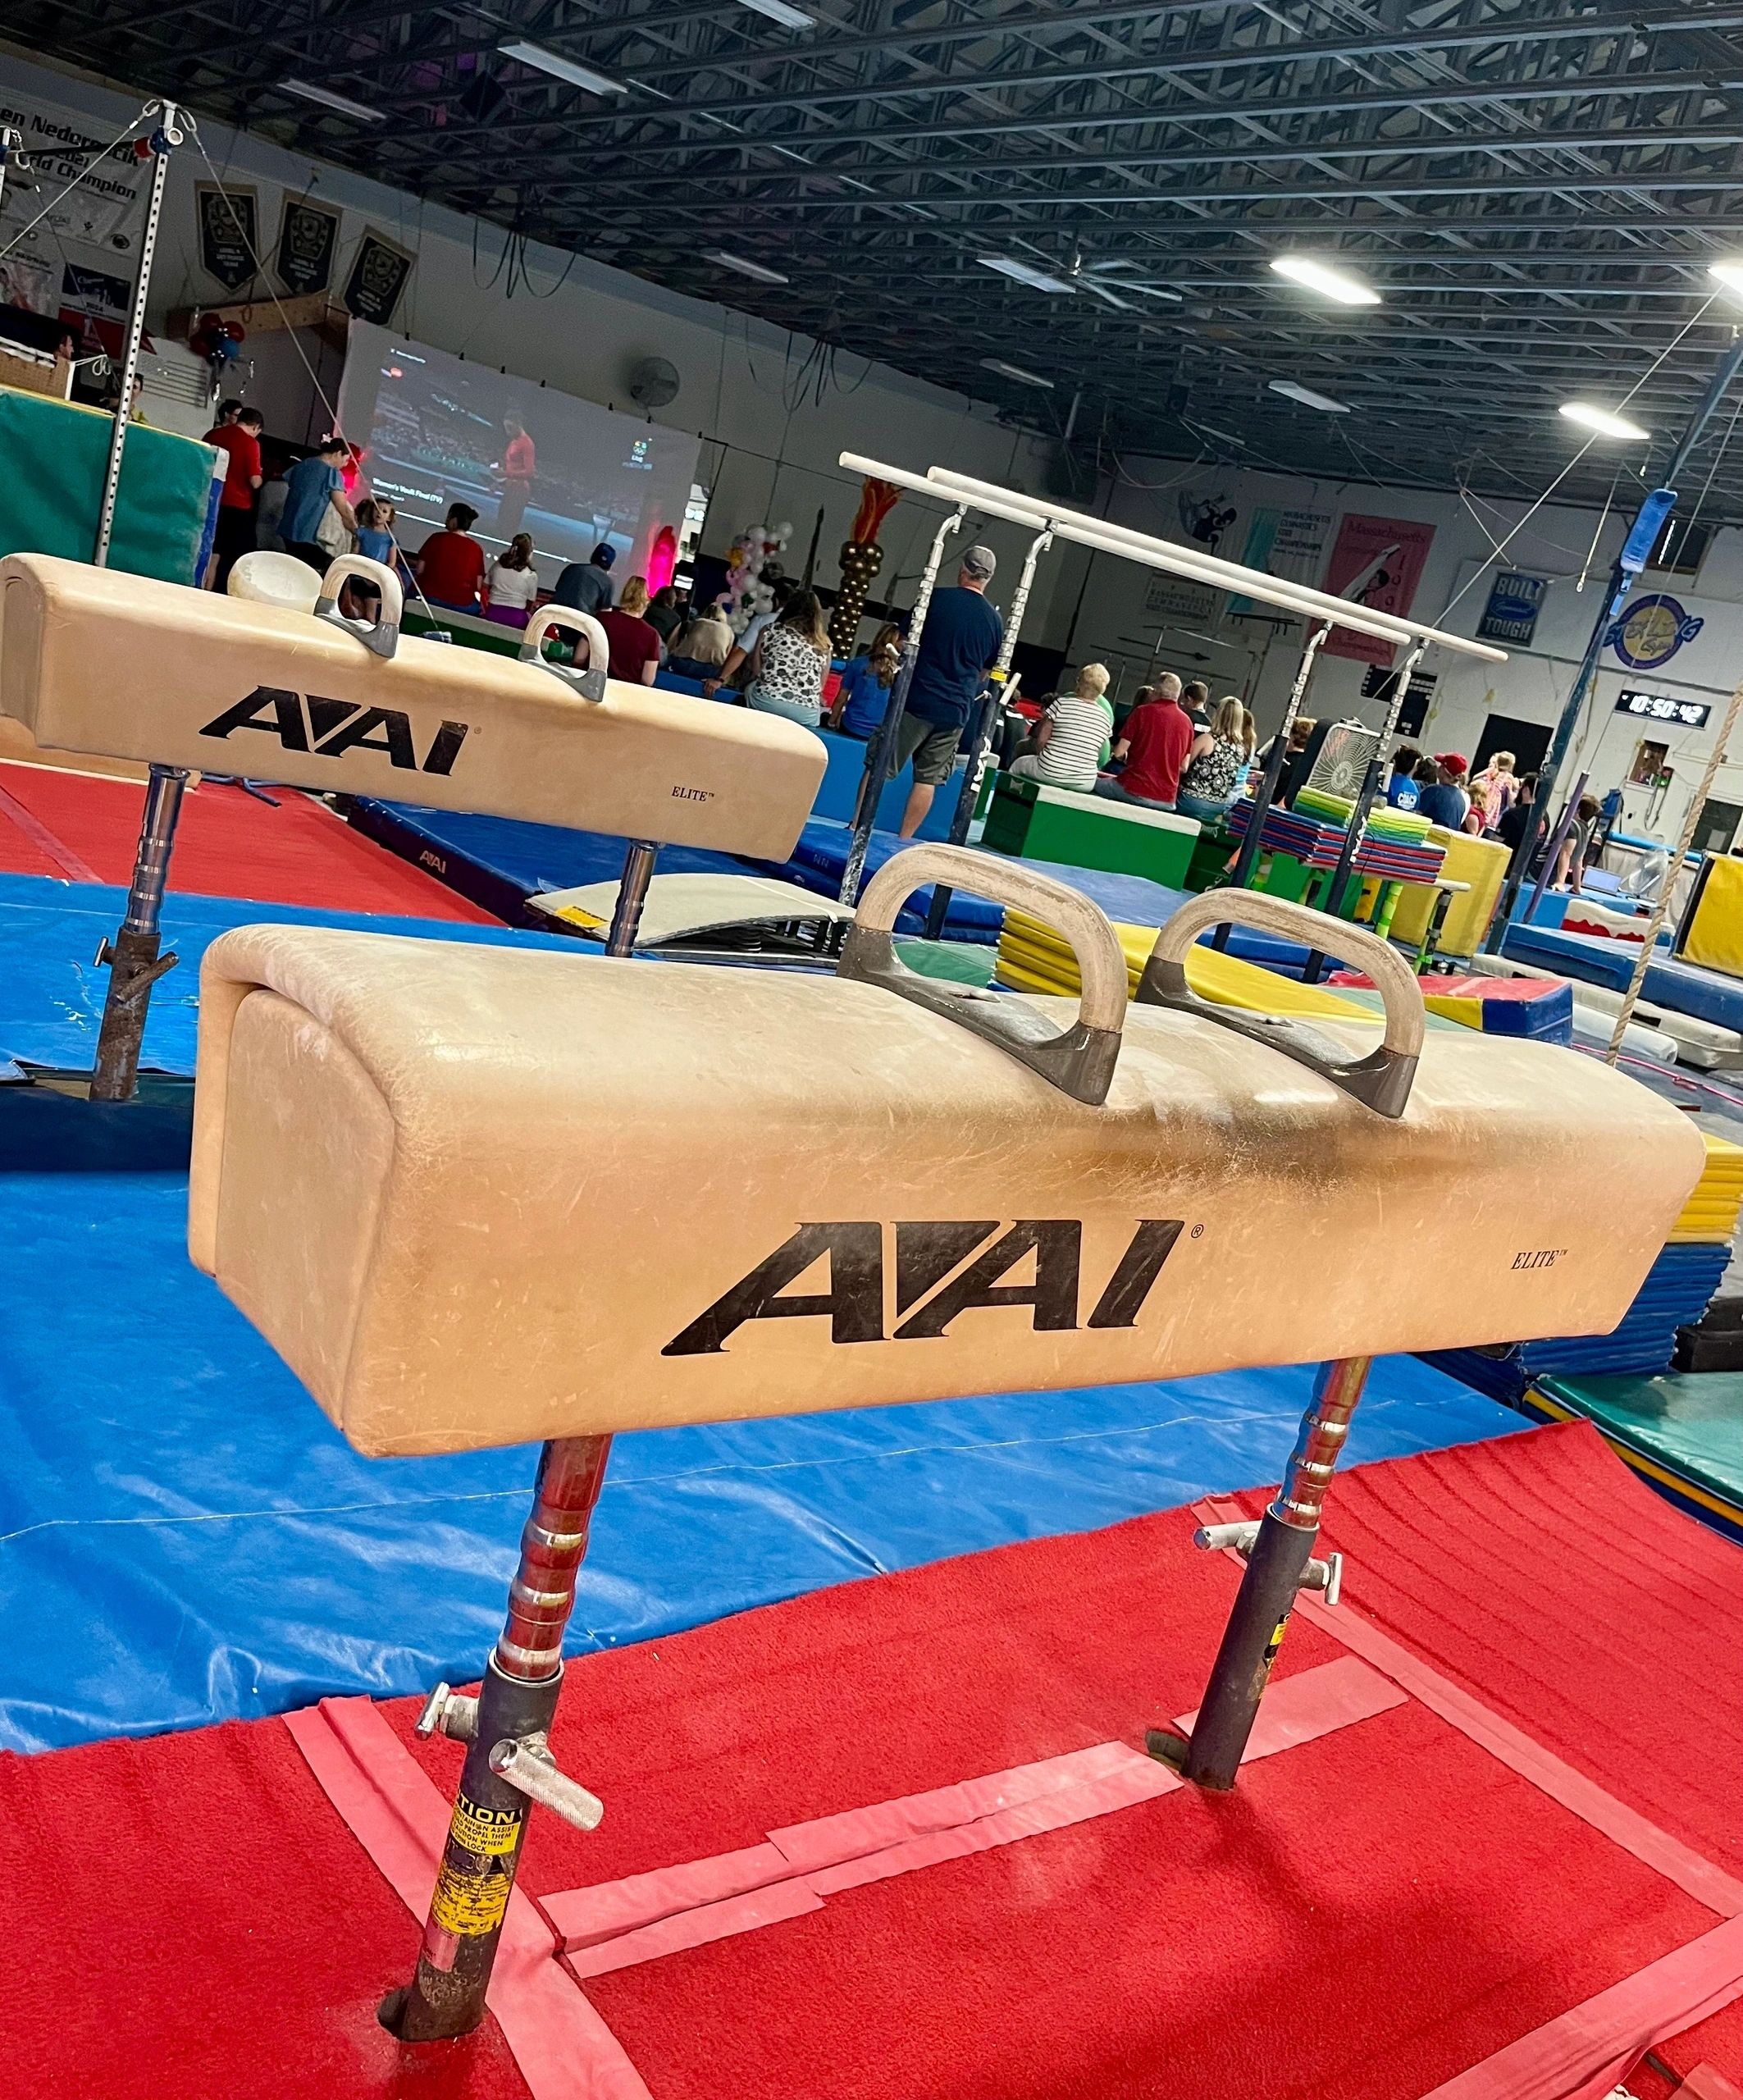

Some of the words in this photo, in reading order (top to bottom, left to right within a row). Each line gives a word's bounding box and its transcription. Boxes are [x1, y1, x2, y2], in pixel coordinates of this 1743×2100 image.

[57, 162, 137, 200] Champion
[1495, 577, 1544, 600] BUILT
[1485, 616, 1532, 640] TOUGH
[1628, 694, 1704, 725] 10:50:42
[491, 1824, 514, 1833] ASSIST
[491, 1832, 512, 1840] THEM
[467, 1841, 486, 1852] LOCK
